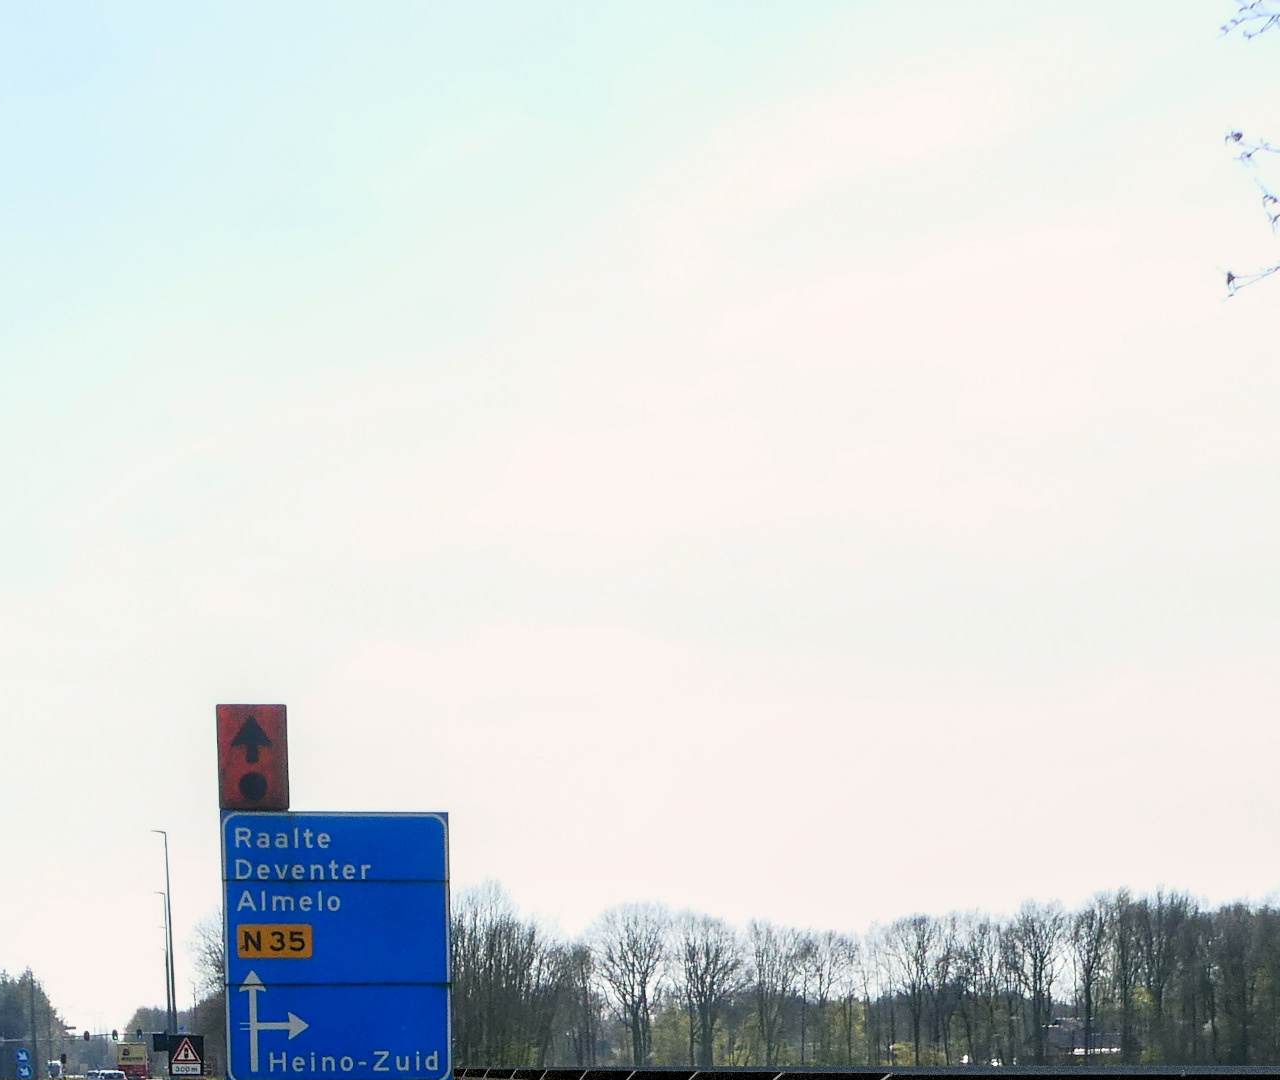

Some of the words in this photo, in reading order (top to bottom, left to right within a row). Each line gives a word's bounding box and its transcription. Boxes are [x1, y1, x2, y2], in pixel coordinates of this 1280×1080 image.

[235, 827, 332, 849] Raalte
[235, 859, 372, 880] Deventer
[237, 890, 341, 911] Almelo
[269, 1050, 439, 1072] Heino-Zuid
